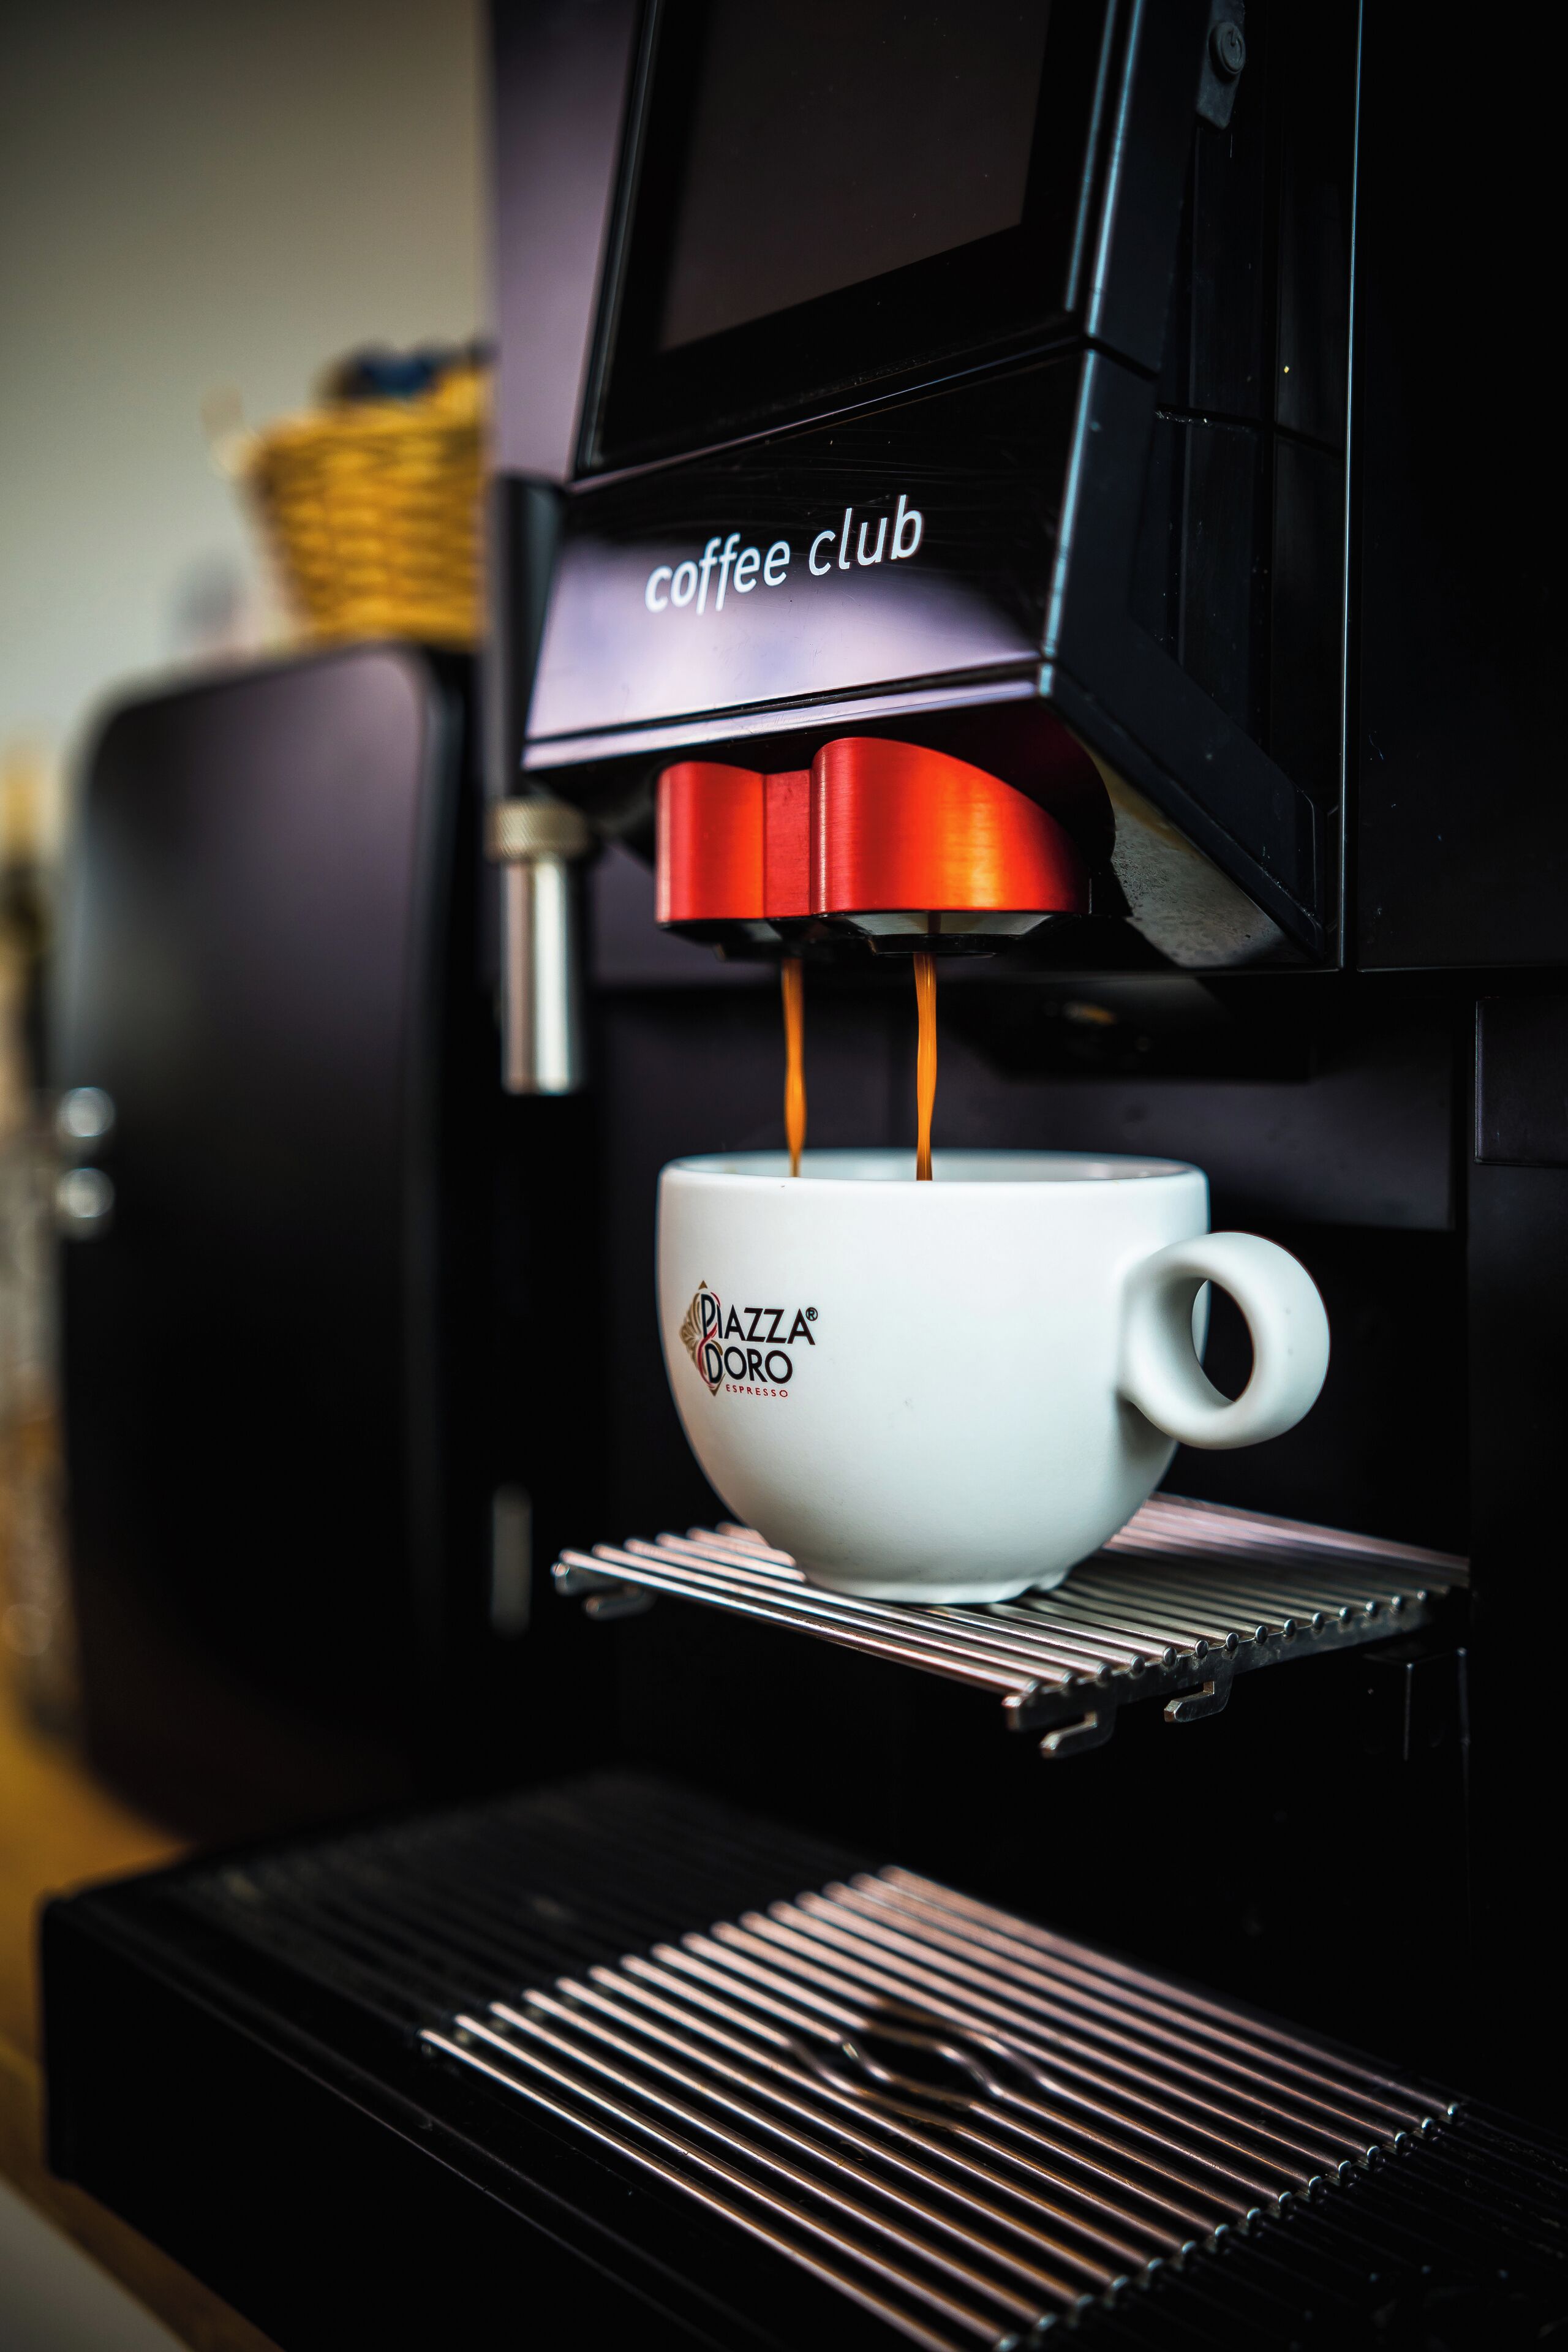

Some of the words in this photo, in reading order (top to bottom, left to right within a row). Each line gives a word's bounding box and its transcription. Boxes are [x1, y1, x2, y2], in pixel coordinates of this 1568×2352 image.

[645, 532, 791, 616] coffee
[809, 494, 924, 576] club
[725, 1384, 789, 1398] ESPRESSO
